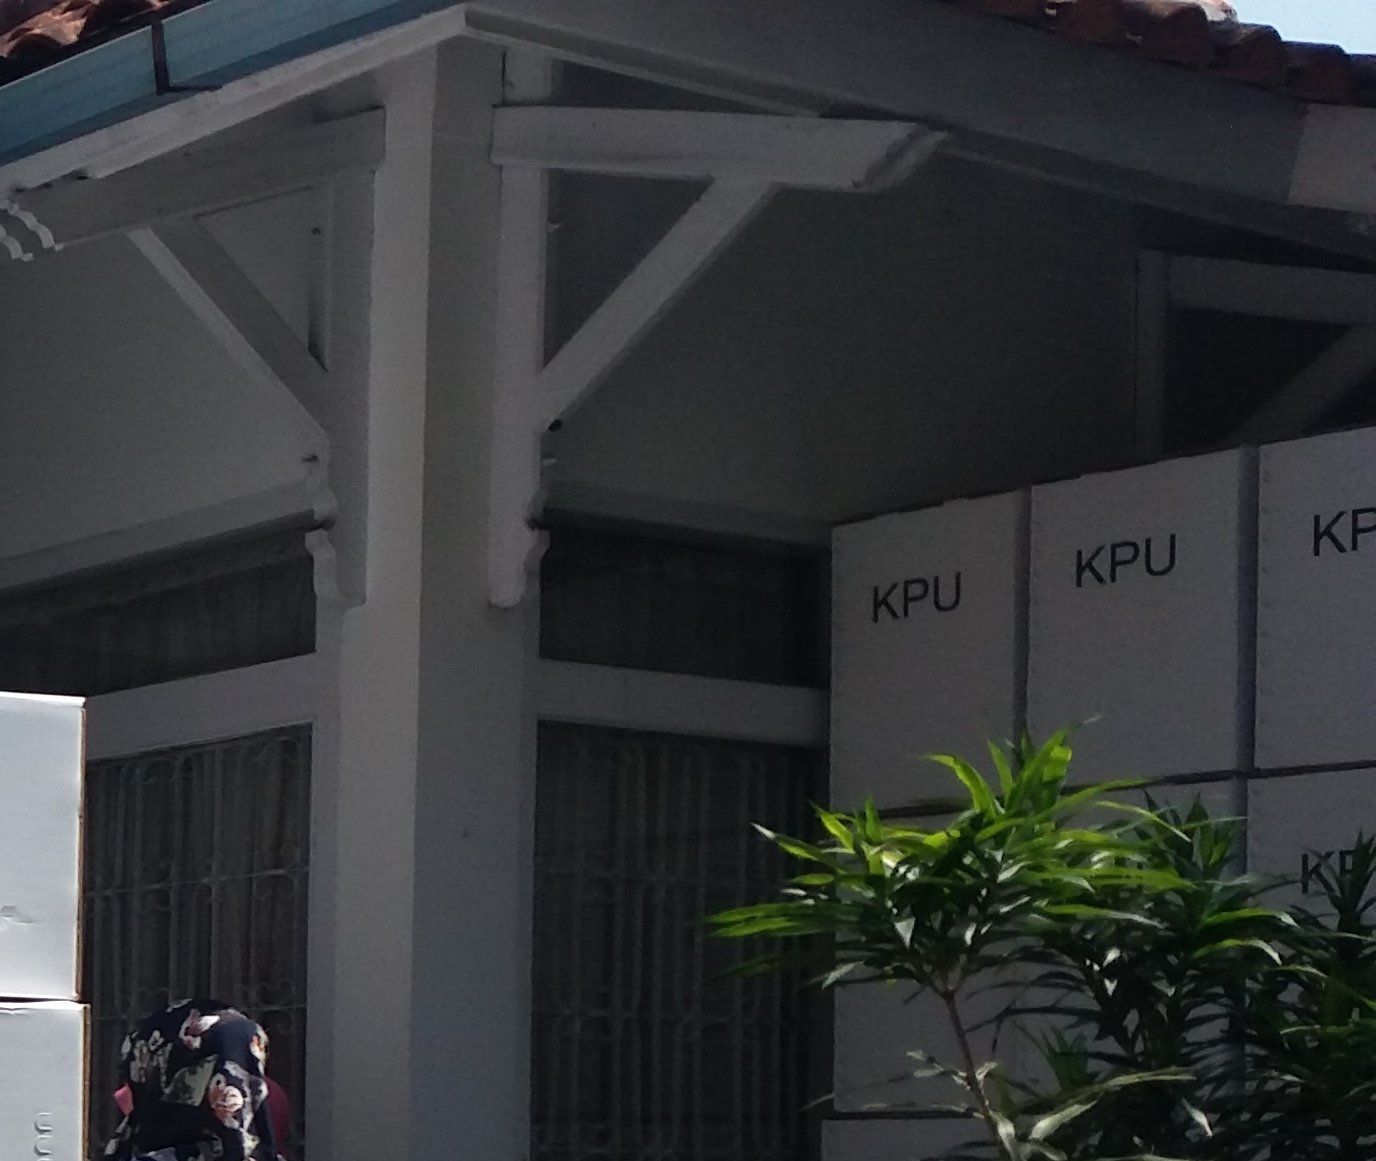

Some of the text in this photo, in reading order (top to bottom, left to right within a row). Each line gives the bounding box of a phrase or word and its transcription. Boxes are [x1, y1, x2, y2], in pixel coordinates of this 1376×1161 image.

[1313, 507, 1376, 557] KP
[1075, 533, 1177, 588] KPU
[871, 571, 963, 624] KPU
